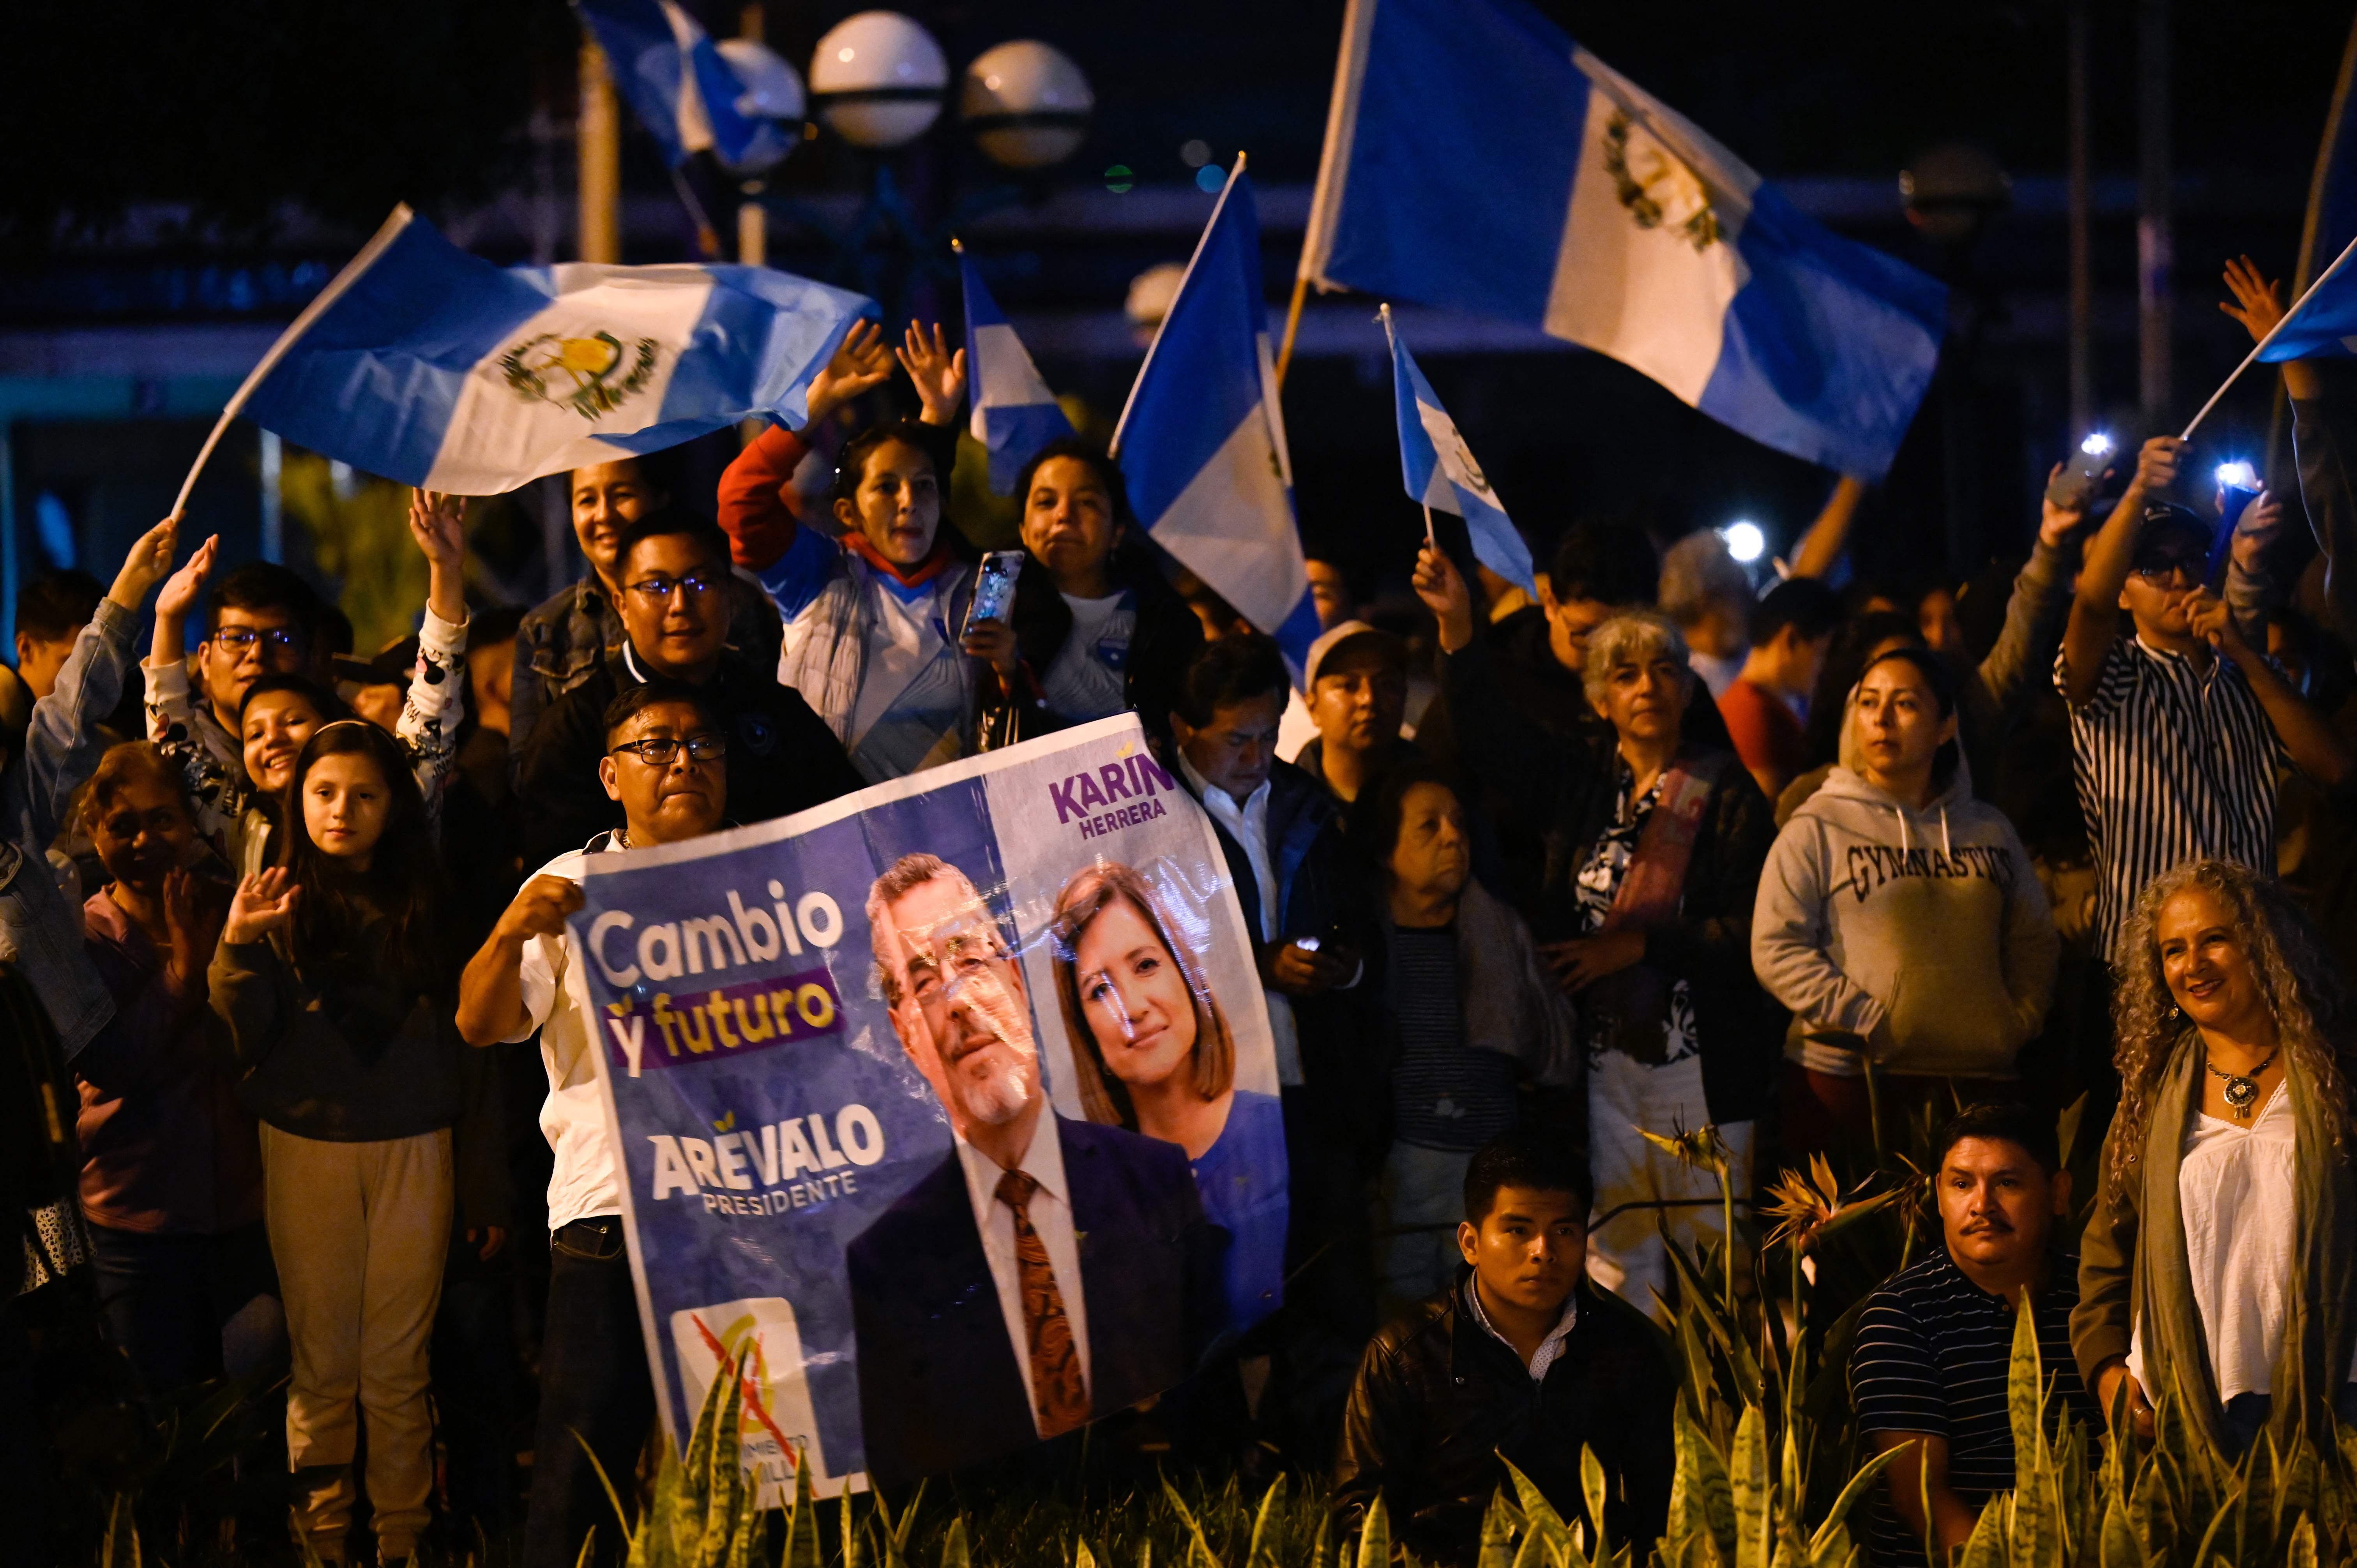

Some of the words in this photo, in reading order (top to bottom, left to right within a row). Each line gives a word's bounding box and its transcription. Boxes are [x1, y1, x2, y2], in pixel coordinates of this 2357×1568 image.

[1079, 798, 1167, 840] HERRERA
[587, 879, 843, 988] Cambio
[652, 983, 834, 1056] futuro
[702, 1170, 859, 1215] PRESIDENTE
